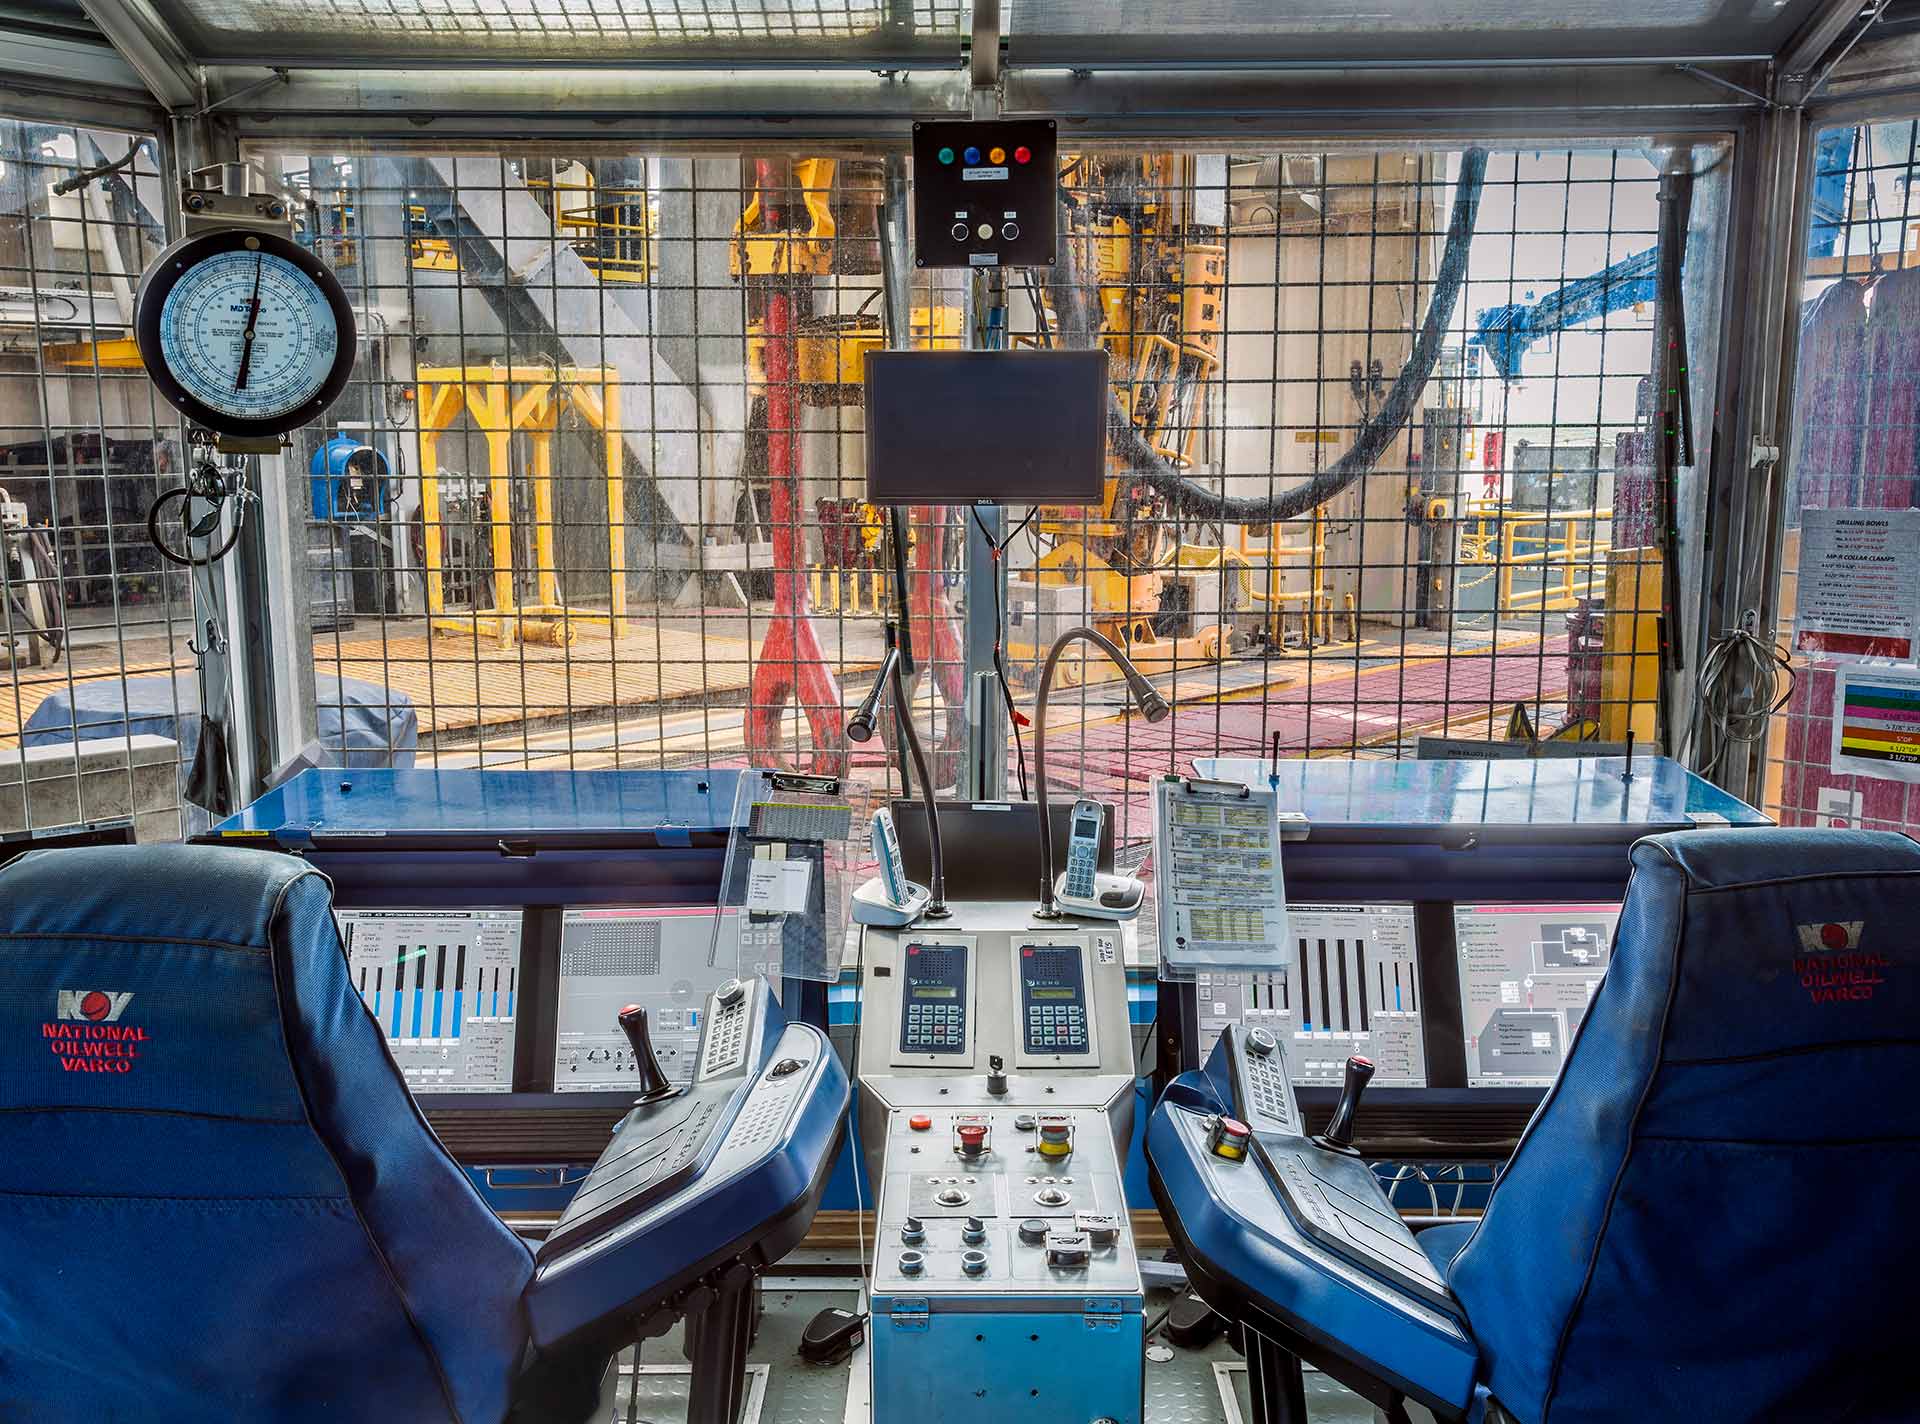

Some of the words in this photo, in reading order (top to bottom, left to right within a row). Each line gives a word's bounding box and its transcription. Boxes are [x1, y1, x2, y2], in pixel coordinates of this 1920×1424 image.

[1810, 986, 1873, 1005] VARCO
[42, 1023, 152, 1041] NATIONAL
[51, 1039, 142, 1057] OILWELL
[61, 1057, 132, 1073] VARCO
